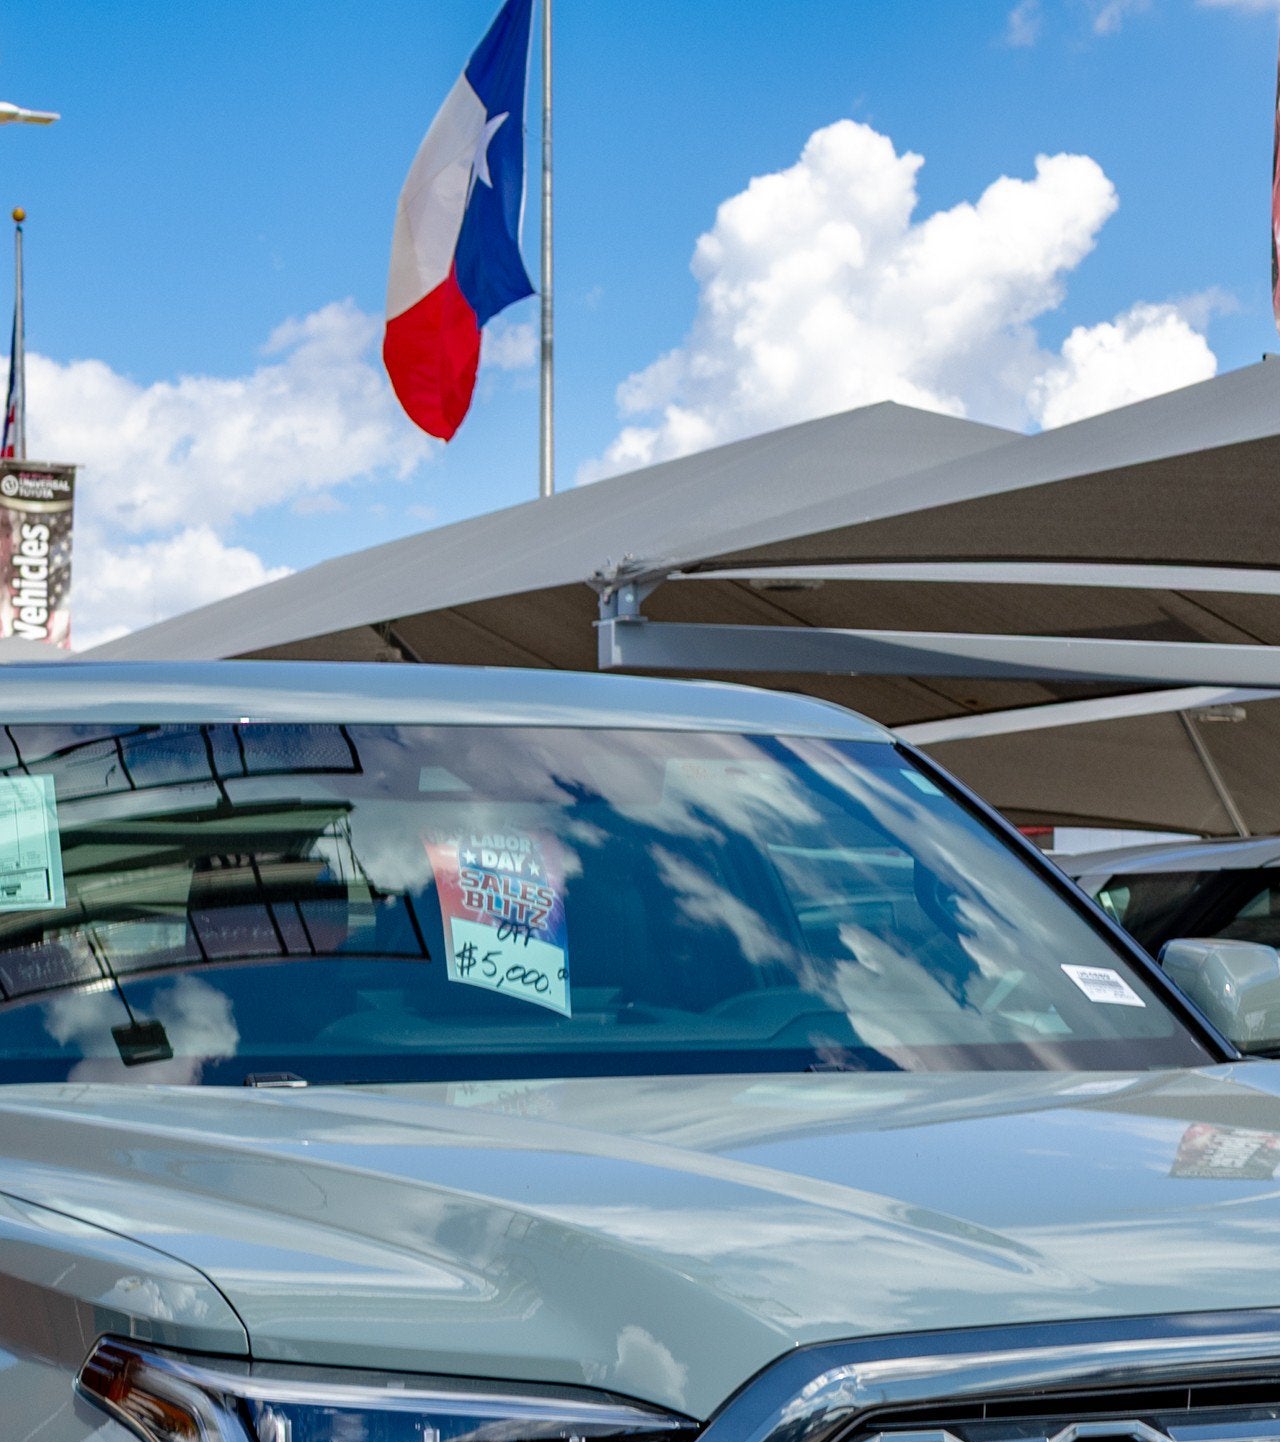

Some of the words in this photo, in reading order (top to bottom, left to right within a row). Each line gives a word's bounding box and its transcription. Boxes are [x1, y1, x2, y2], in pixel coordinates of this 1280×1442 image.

[471, 834, 532, 854] LABOR
[482, 849, 527, 873] DAY
[460, 868, 555, 908] SALES
[464, 890, 549, 928] BLITZ
